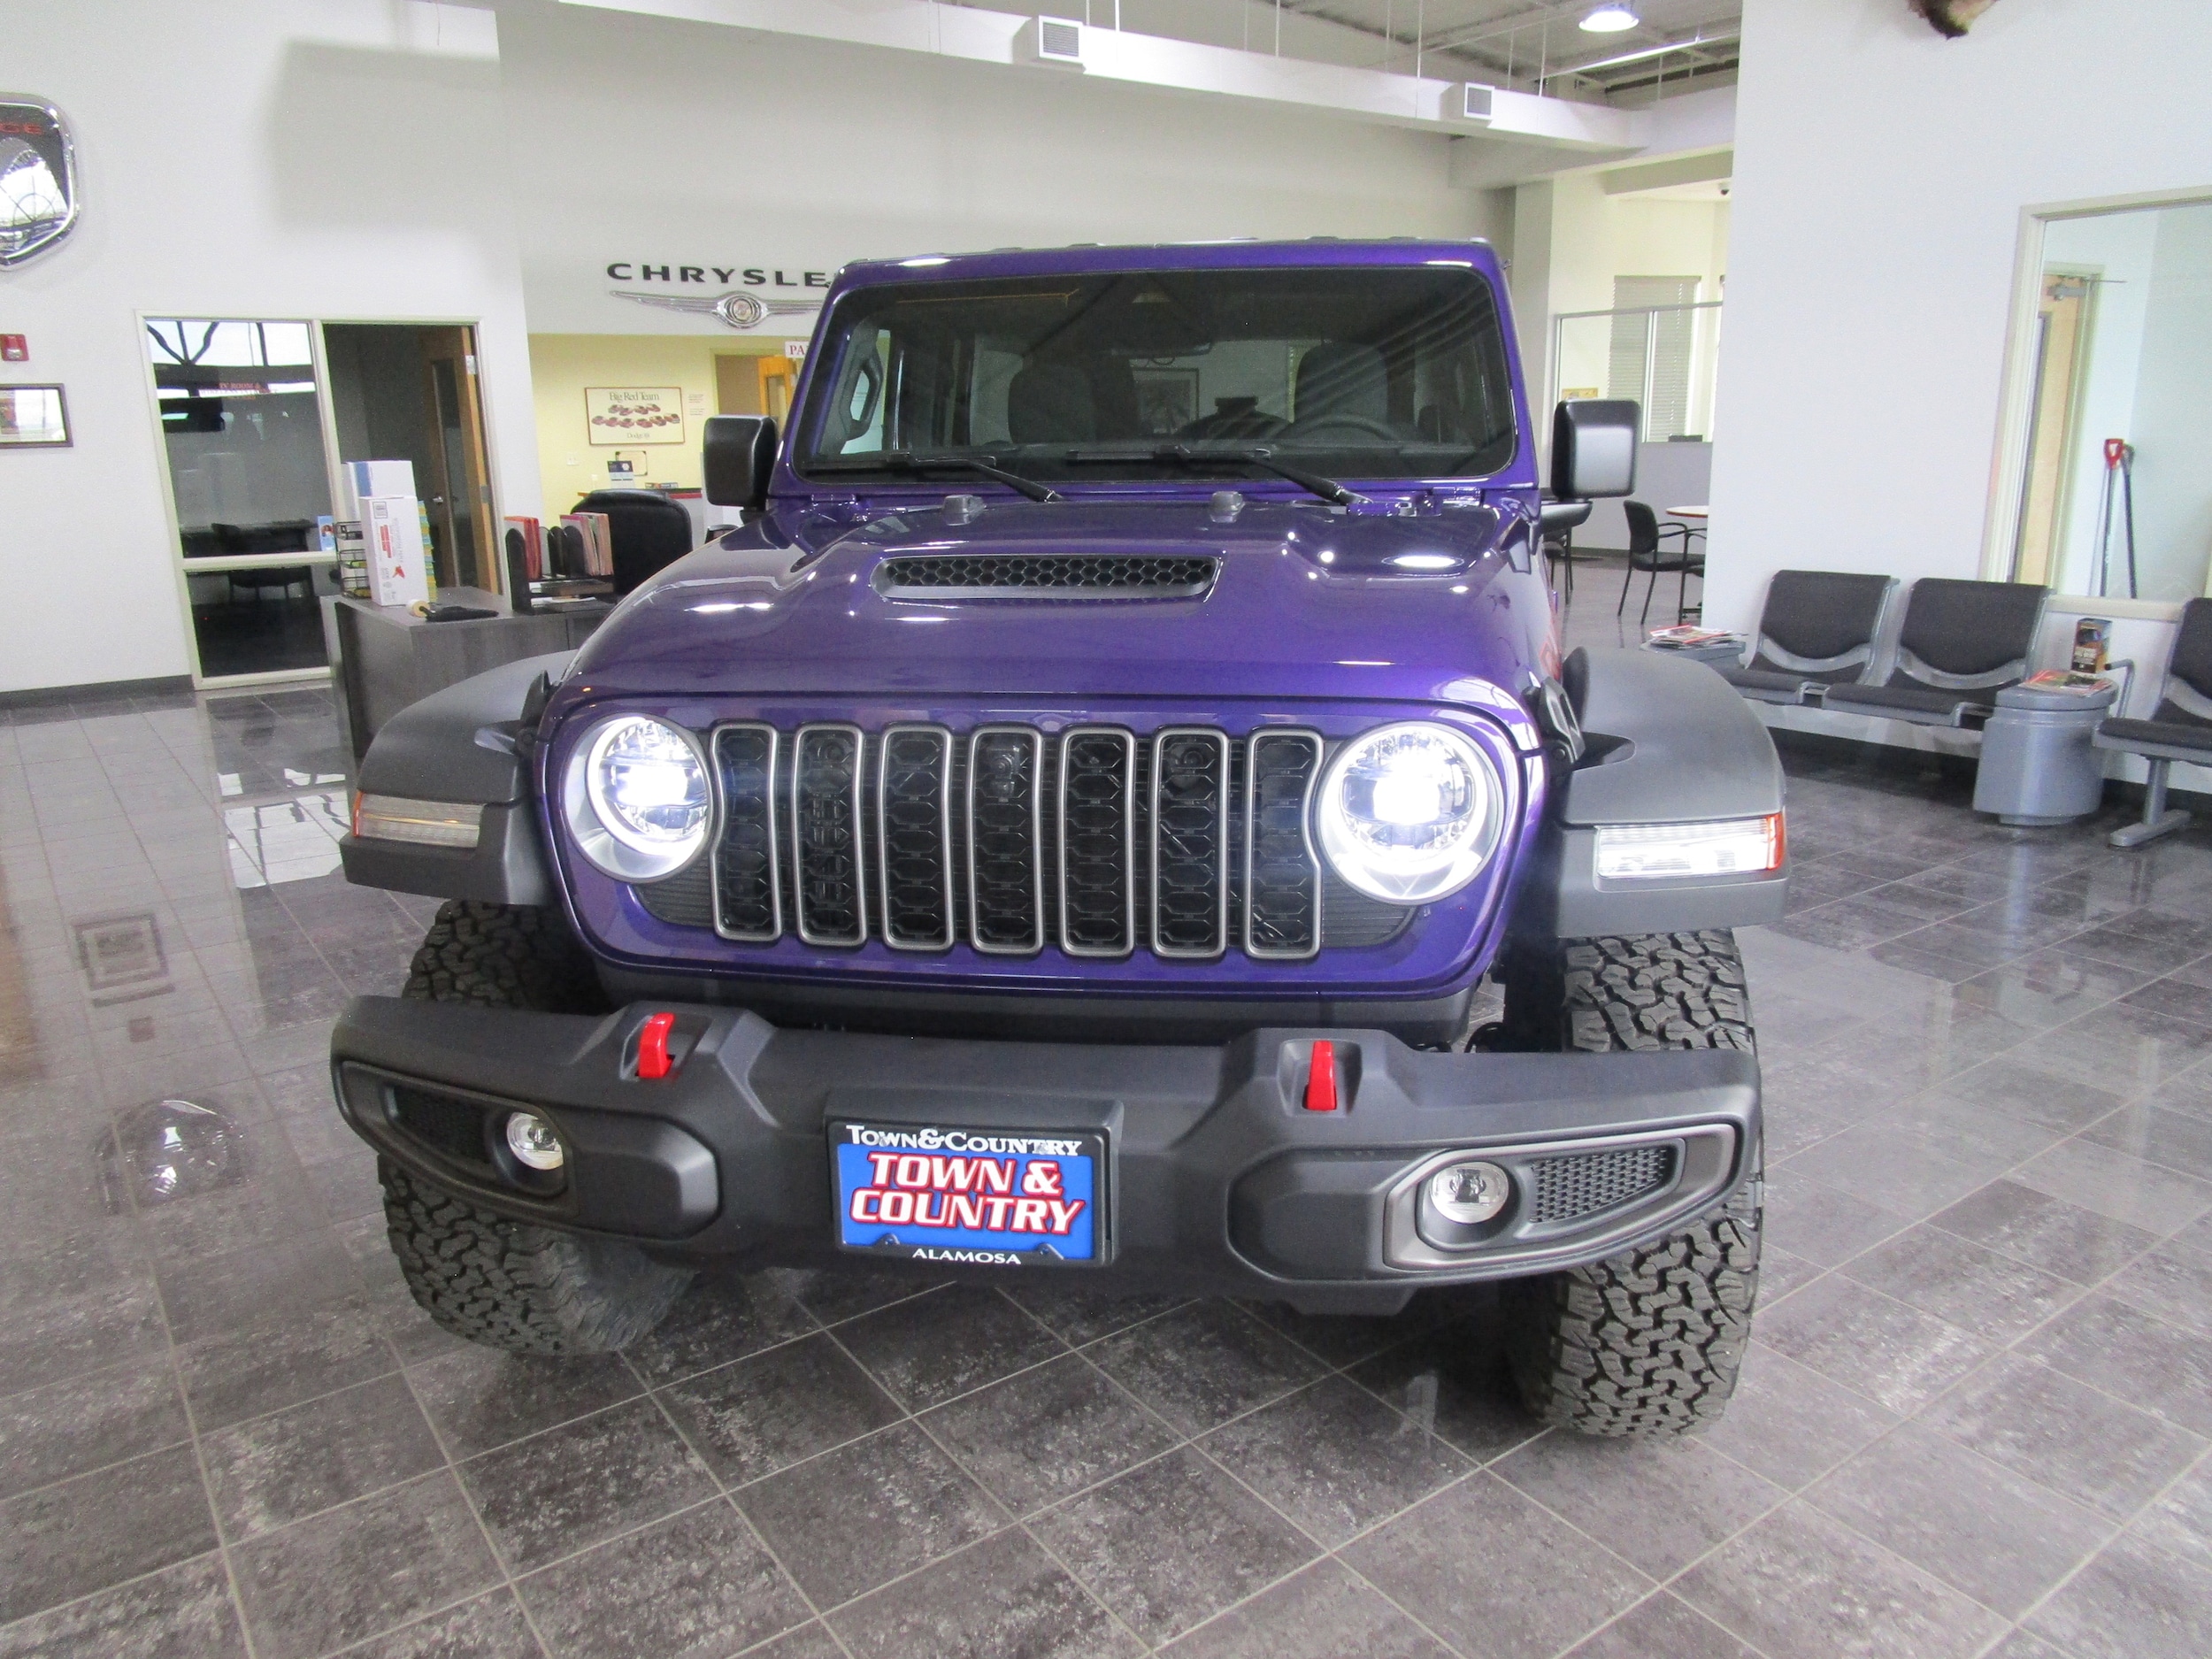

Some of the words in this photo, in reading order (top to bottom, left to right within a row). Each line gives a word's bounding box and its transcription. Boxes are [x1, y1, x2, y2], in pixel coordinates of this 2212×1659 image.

[607, 263, 830, 288] CHRYSLE
[789, 344, 809, 356] PA
[610, 392, 623, 403] Big
[868, 1151, 1016, 1194] TOWN
[1021, 1159, 1064, 1196] &
[850, 1187, 1087, 1235] COUNTRY
[912, 1248, 1021, 1265] ALAMOSA
